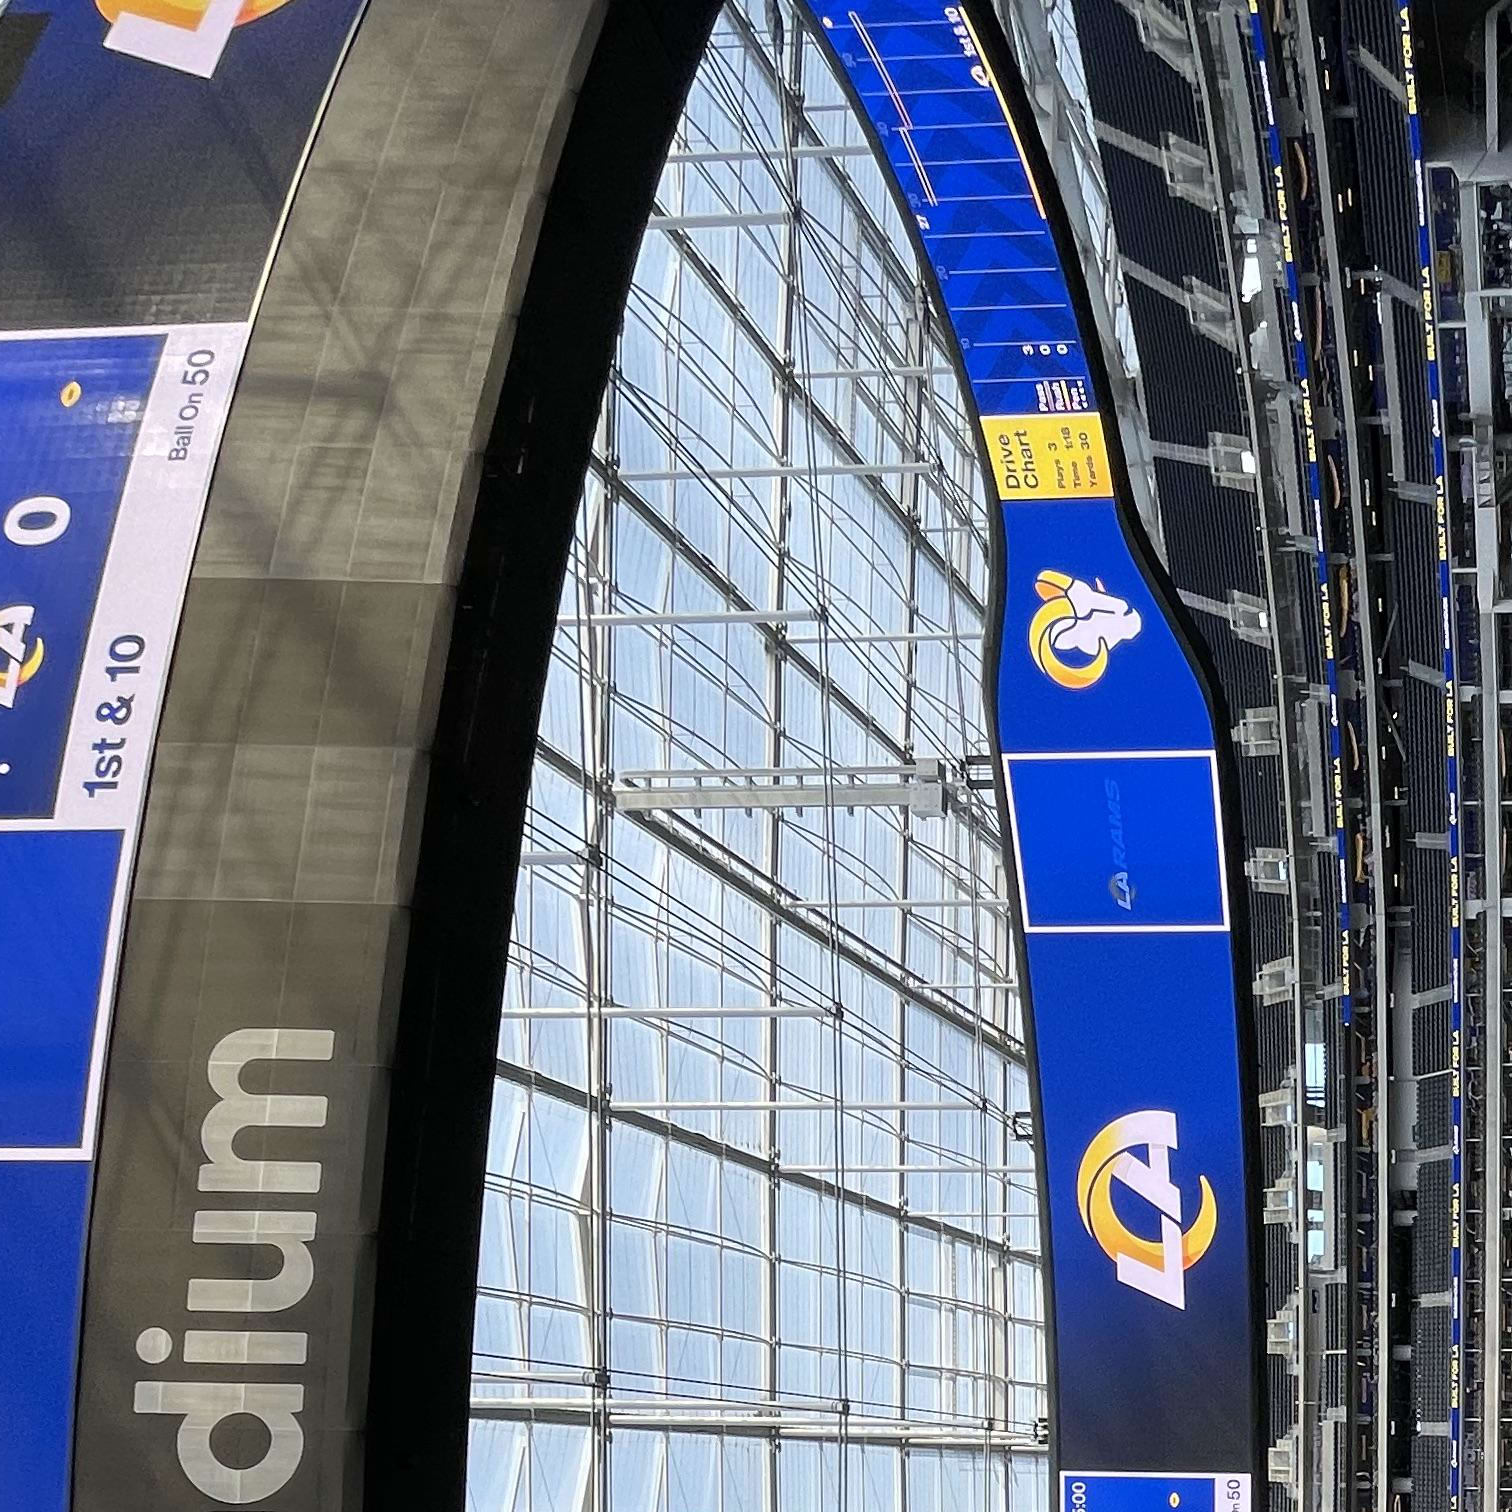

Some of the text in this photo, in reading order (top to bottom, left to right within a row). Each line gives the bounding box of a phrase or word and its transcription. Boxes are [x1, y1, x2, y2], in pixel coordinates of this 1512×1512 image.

[944, 7, 977, 57] 1st & 10
[1400, 7, 1416, 114] BUILT FOR LA
[915, 214, 930, 230] 27
[1274, 166, 1292, 262] BUILT FOR LA
[1039, 344, 1051, 355] 0
[1056, 344, 1068, 355] 0
[168, 349, 215, 462] Ball On 50
[1022, 344, 1048, 412] Pass 3
[998, 434, 1020, 489] Drive
[1014, 430, 1038, 489] Chart
[1048, 442, 1066, 488] Plays 3
[1071, 461, 1082, 488] Time
[1078, 432, 1098, 488] Yards 30
[4, 496, 71, 546] 0
[83, 634, 145, 798] 1st & 10
[1104, 778, 1128, 870] RAMS
[1226, 1480, 1240, 1500] 50
